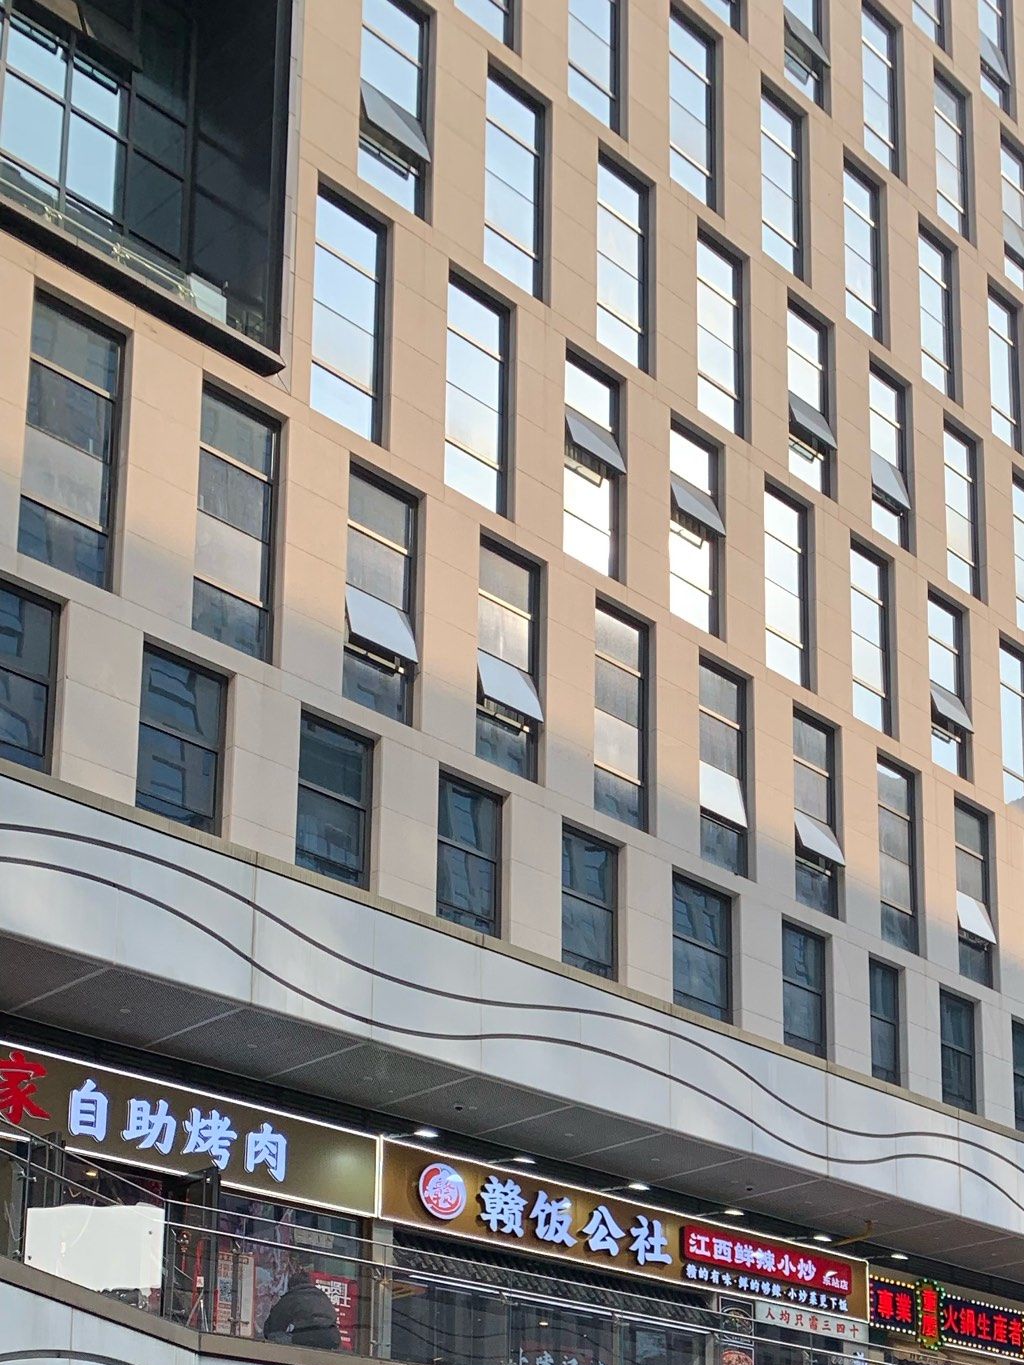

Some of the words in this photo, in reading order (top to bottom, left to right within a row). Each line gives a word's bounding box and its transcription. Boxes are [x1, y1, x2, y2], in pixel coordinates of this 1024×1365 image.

[68, 1078, 288, 1184] 自助烤肉
[480, 1175, 673, 1266] 赣饭公社
[688, 1232, 817, 1282] 江西鲜辣小炒
